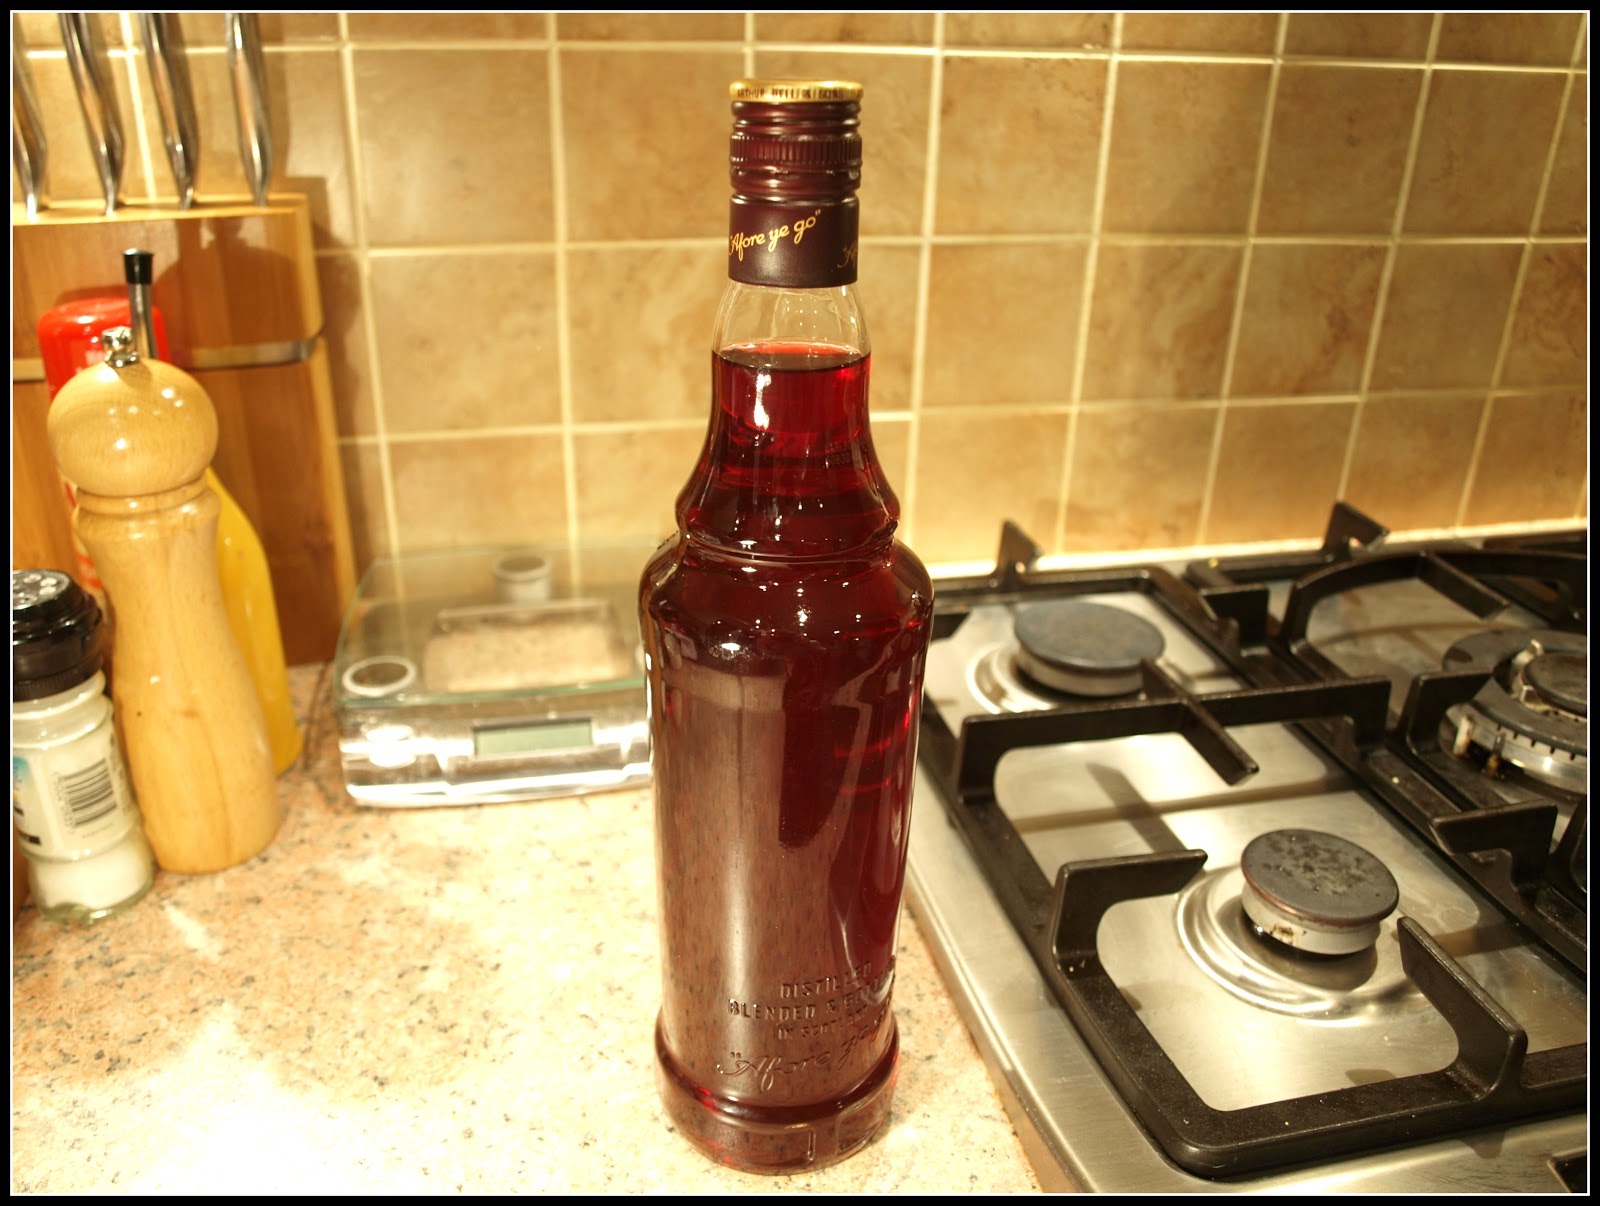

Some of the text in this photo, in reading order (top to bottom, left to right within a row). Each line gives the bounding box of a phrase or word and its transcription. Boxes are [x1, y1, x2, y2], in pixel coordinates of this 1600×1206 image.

[768, 225, 790, 253] ye
[779, 961, 872, 999] DISTILLED
[727, 998, 816, 1021] BLENDED
